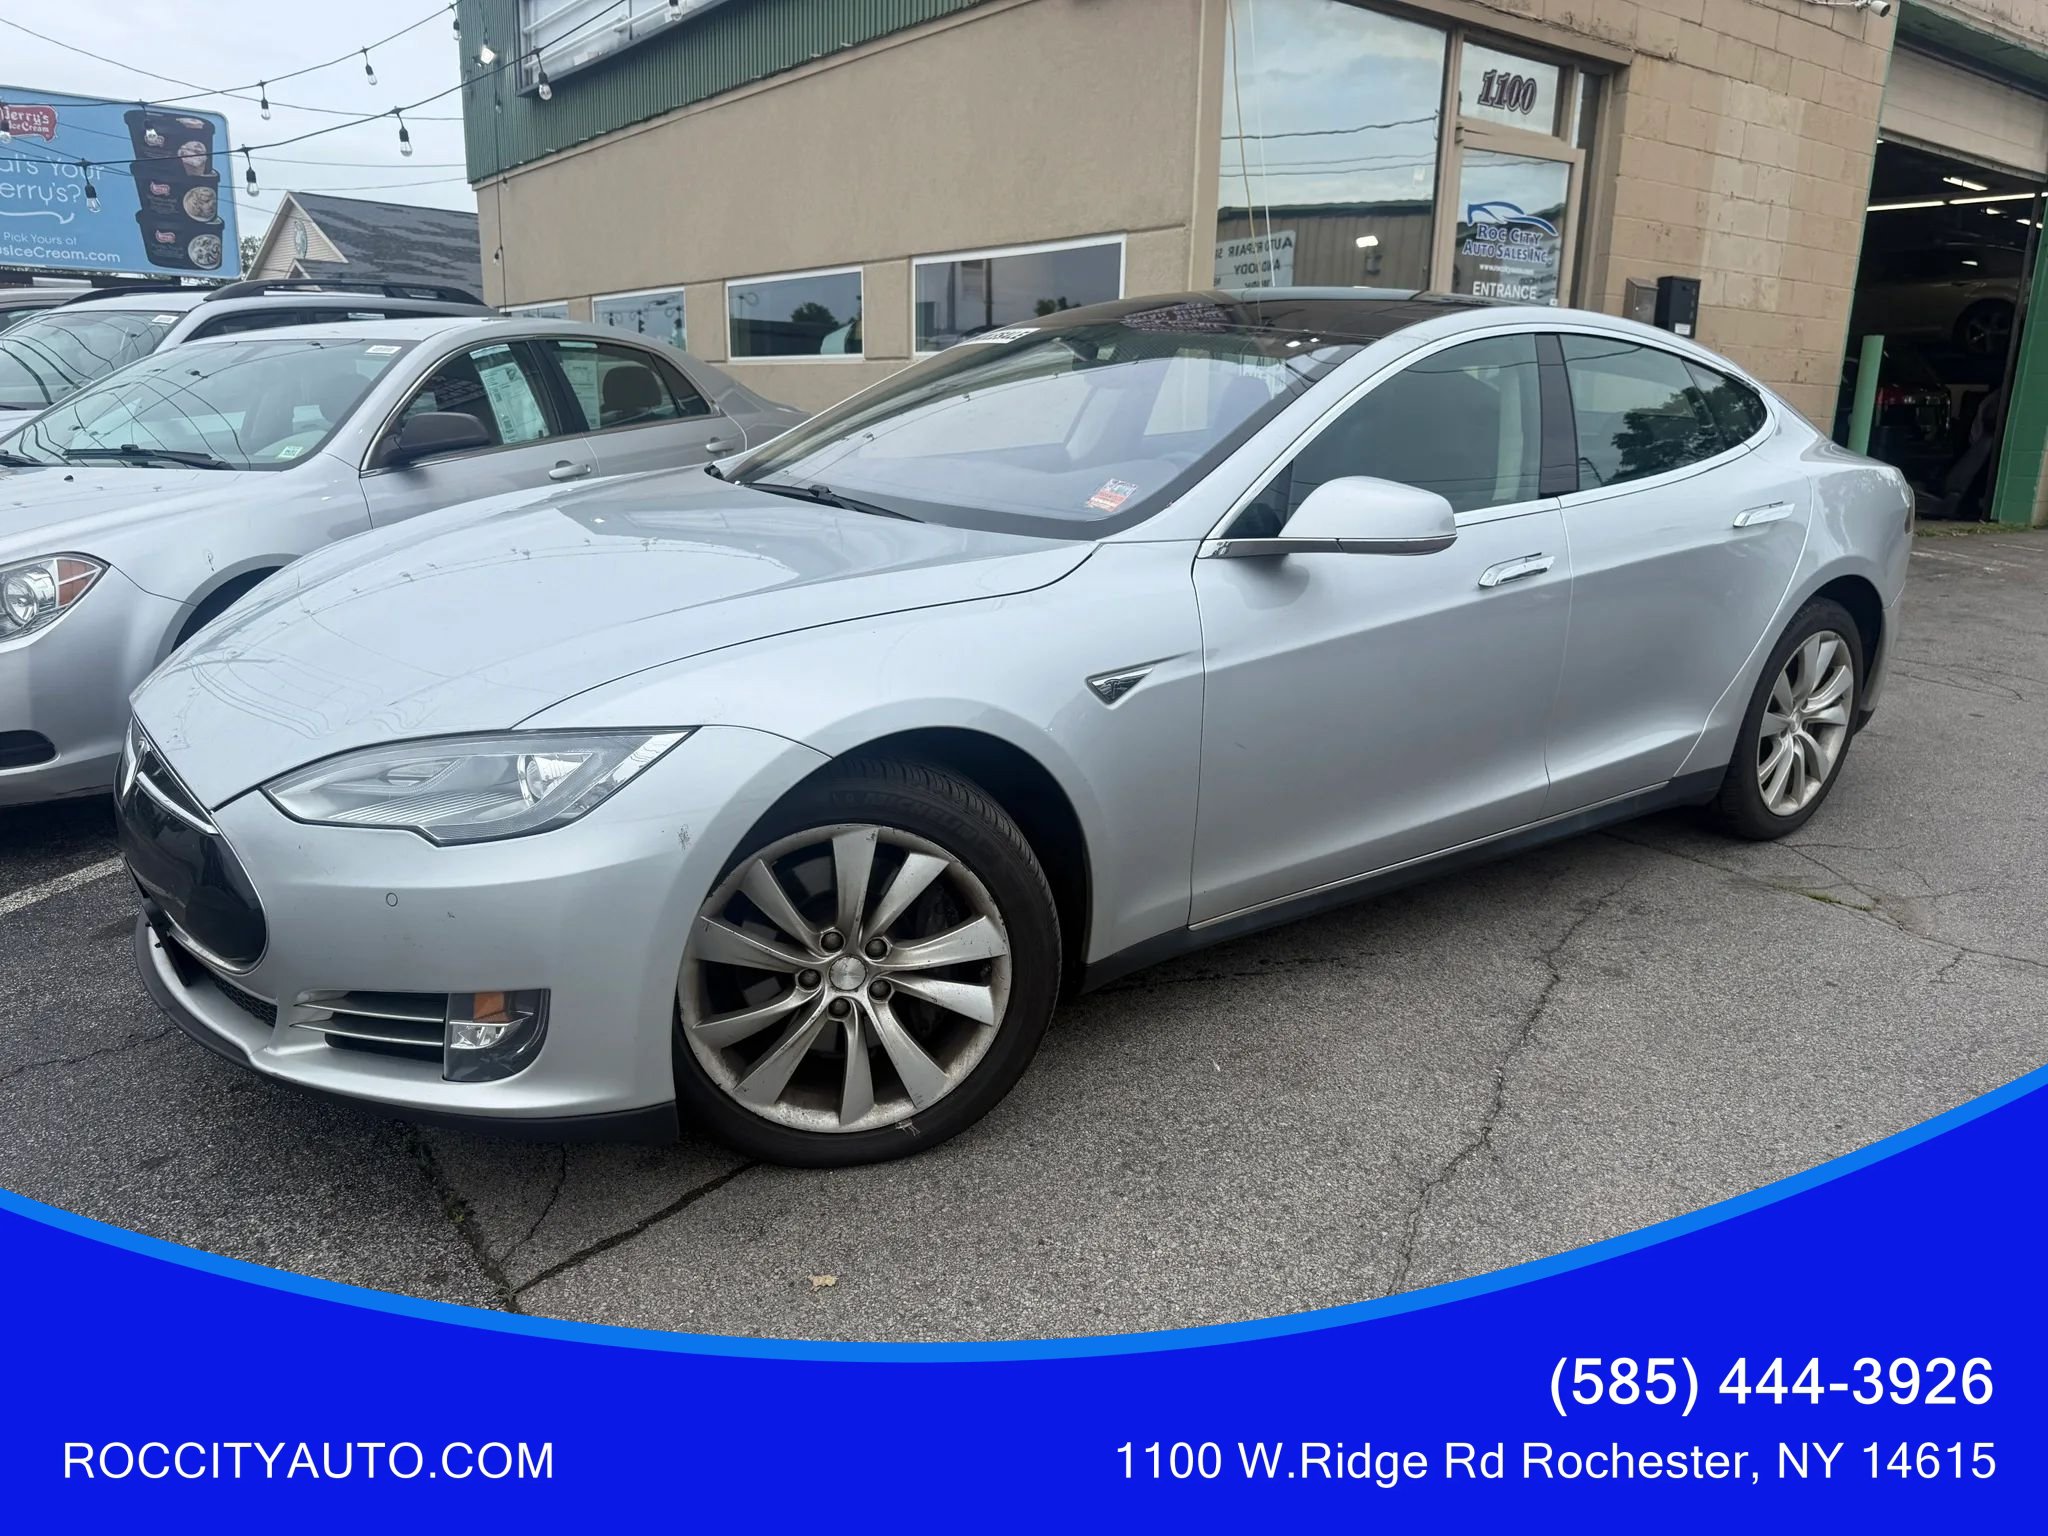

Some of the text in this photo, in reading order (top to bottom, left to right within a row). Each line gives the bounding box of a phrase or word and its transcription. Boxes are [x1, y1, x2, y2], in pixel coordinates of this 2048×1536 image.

[1477, 69, 1537, 115] 1100
[46, 156, 104, 180] Your
[3, 231, 77, 245] Pick Yours at
[1476, 223, 1543, 246] ROC CITY
[0, 245, 120, 263] sIceCream.com
[1462, 239, 1495, 257] AUTO
[1496, 243, 1528, 262] SALES
[1472, 281, 1538, 300] ENTRANCE
